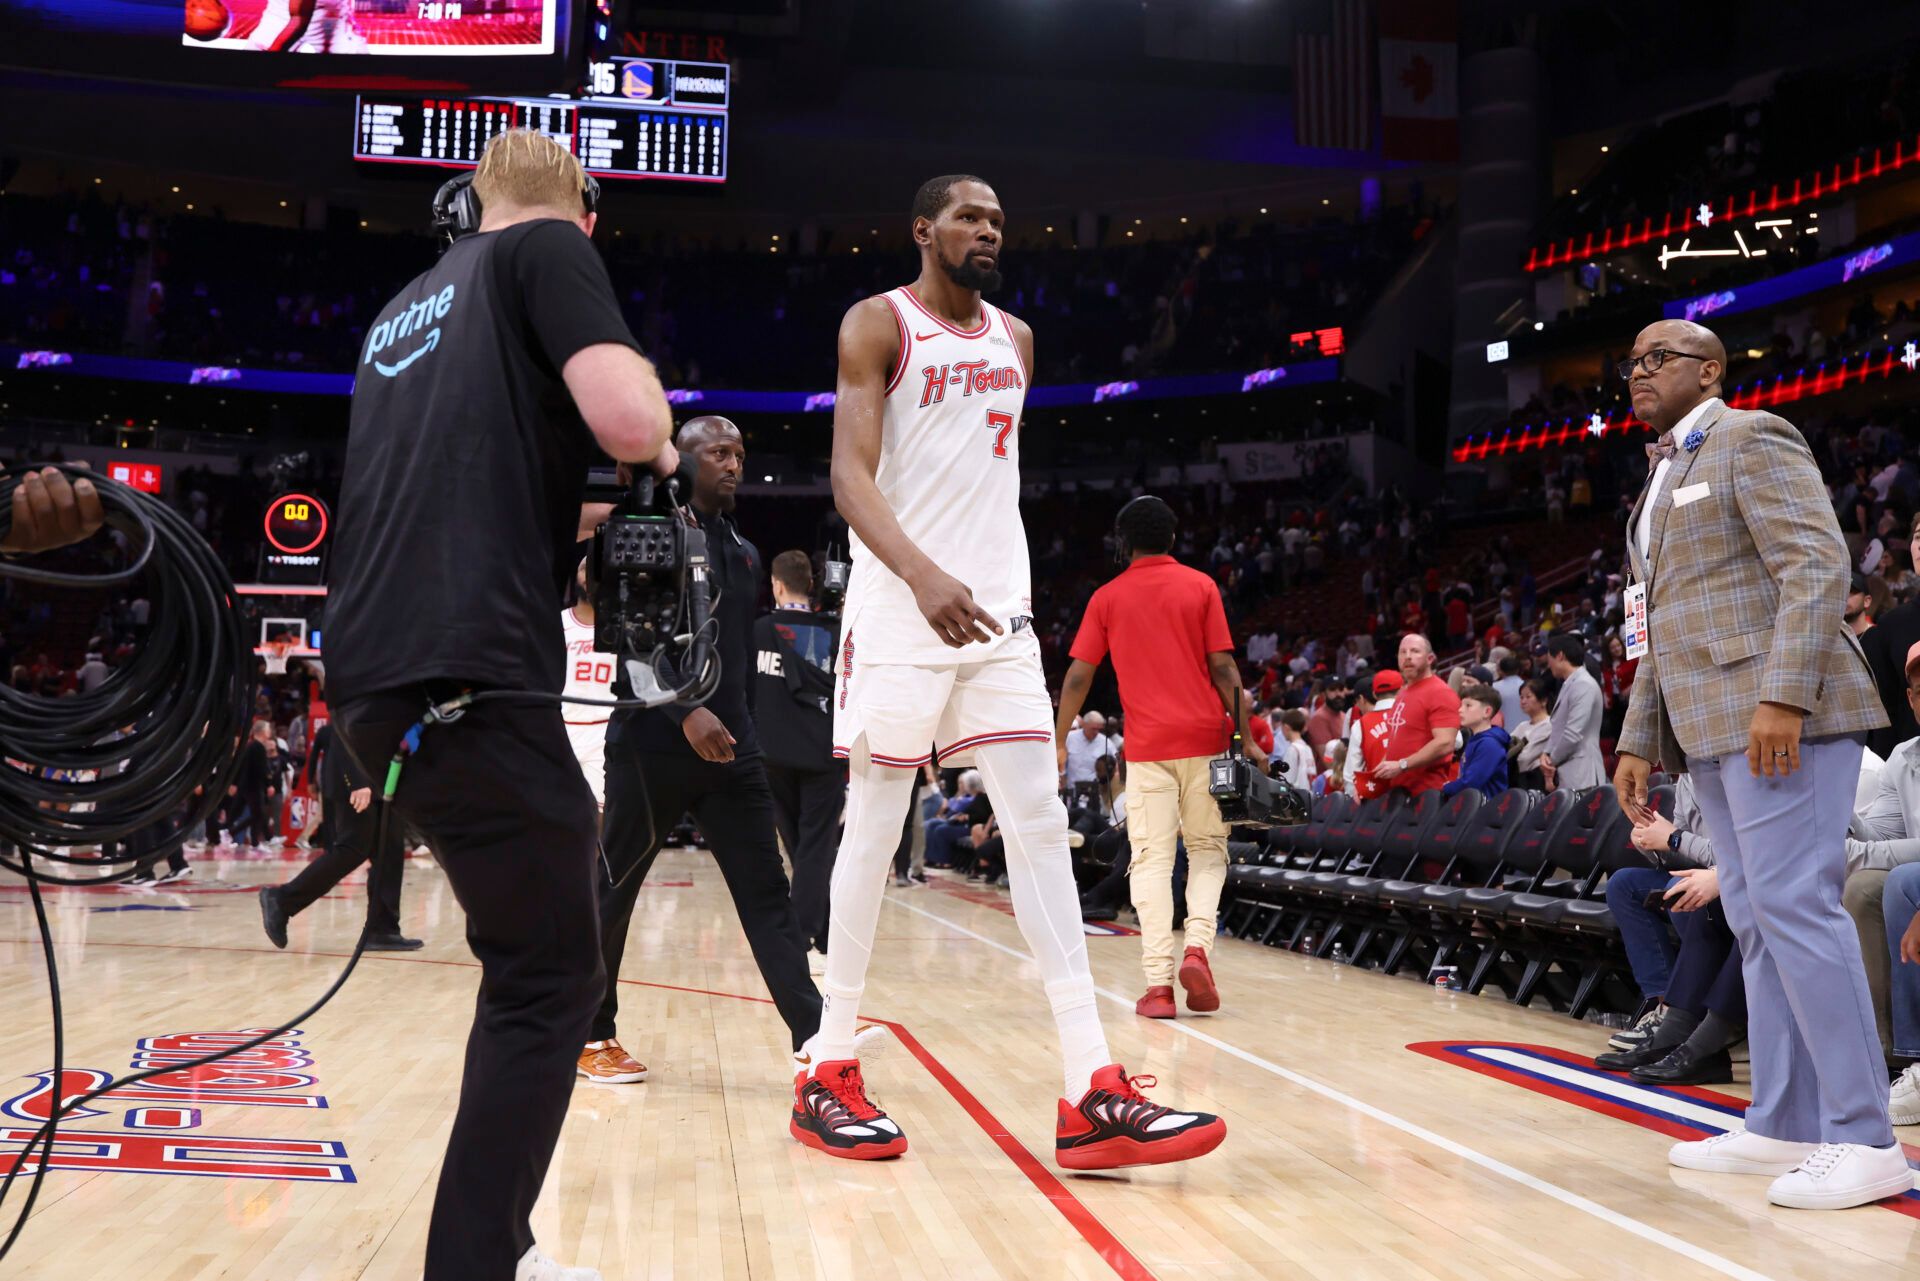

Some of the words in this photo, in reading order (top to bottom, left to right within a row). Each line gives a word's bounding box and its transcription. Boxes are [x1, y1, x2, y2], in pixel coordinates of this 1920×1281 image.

[445, 3, 461, 20] PM
[623, 31, 727, 61] NTER
[364, 284, 455, 365] prime
[919, 358, 1023, 408] H-Town
[986, 409, 1014, 460] 7
[281, 555, 320, 566] TISSOT
[575, 661, 612, 684] 20
